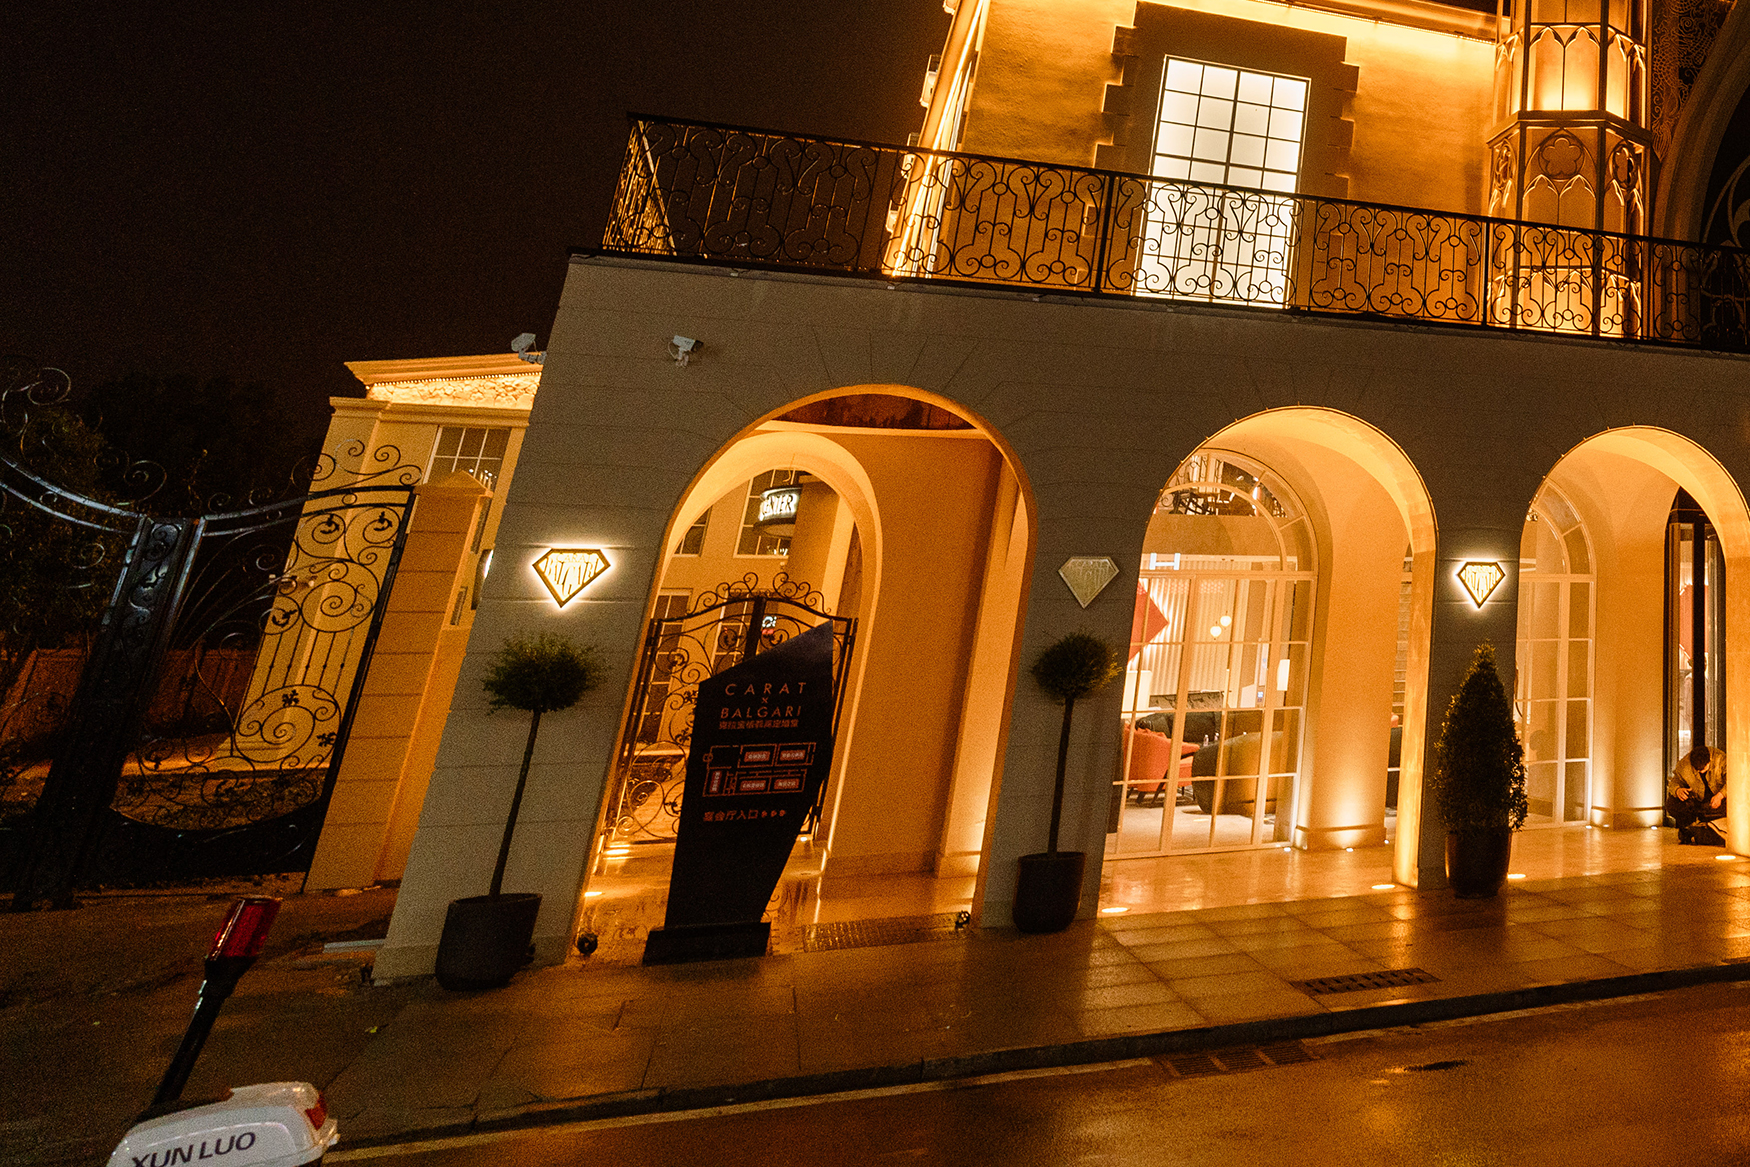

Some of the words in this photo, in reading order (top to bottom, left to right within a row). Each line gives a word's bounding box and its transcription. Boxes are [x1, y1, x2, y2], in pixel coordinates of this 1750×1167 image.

[725, 682, 806, 696] CARAT
[720, 705, 802, 719] BALGARI
[131, 1144, 194, 1167] XUN
[198, 1132, 256, 1160] LUO
